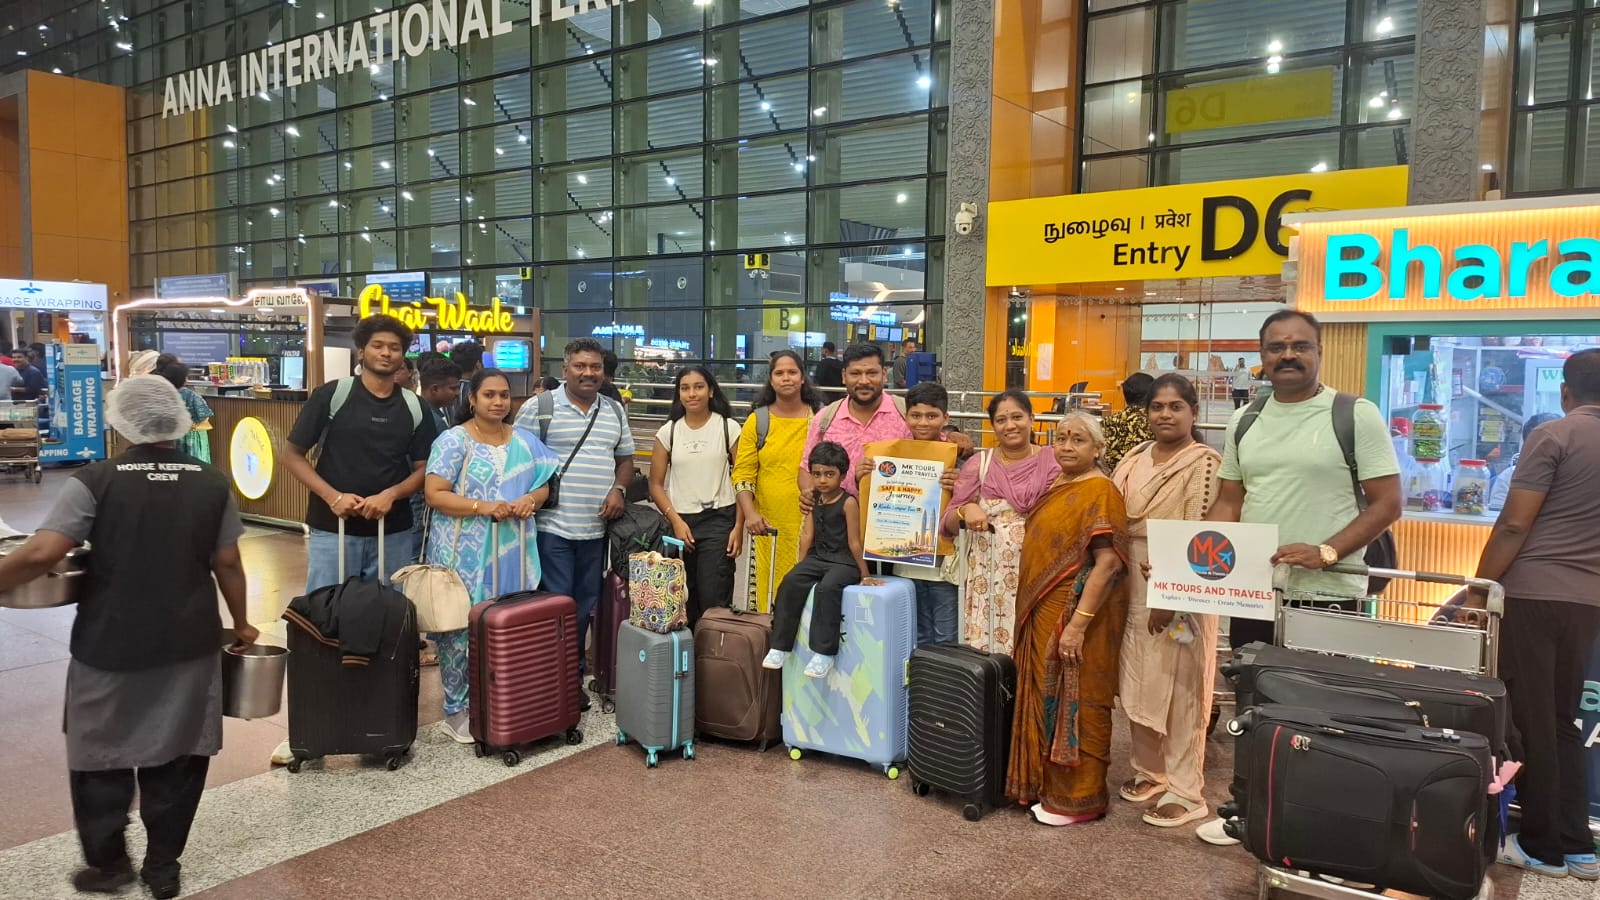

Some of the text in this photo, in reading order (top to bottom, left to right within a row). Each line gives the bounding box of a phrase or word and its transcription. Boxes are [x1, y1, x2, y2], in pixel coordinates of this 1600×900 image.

[162, 0, 513, 119] ANNA INTERNATIONAL
[1044, 216, 1131, 244] நுழைவு
[1154, 209, 1192, 229] प्रवेश
[1113, 241, 1191, 272] Entry
[1324, 228, 1600, 301] Bhara
[0, 296, 103, 310] AGE WRAPPING
[424, 291, 515, 333] Waale
[779, 309, 790, 331] B
[72, 380, 83, 436] BAGGAGE
[86, 377, 97, 438] WRAPPING
[38, 449, 69, 457] APPING
[116, 462, 156, 471] HOUSE
[146, 472, 179, 481] CREW
[915, 464, 936, 472] TOURS
[1193, 536, 1231, 572] MK
[1153, 582, 1273, 600] MK TOURS AND TRAVELS
